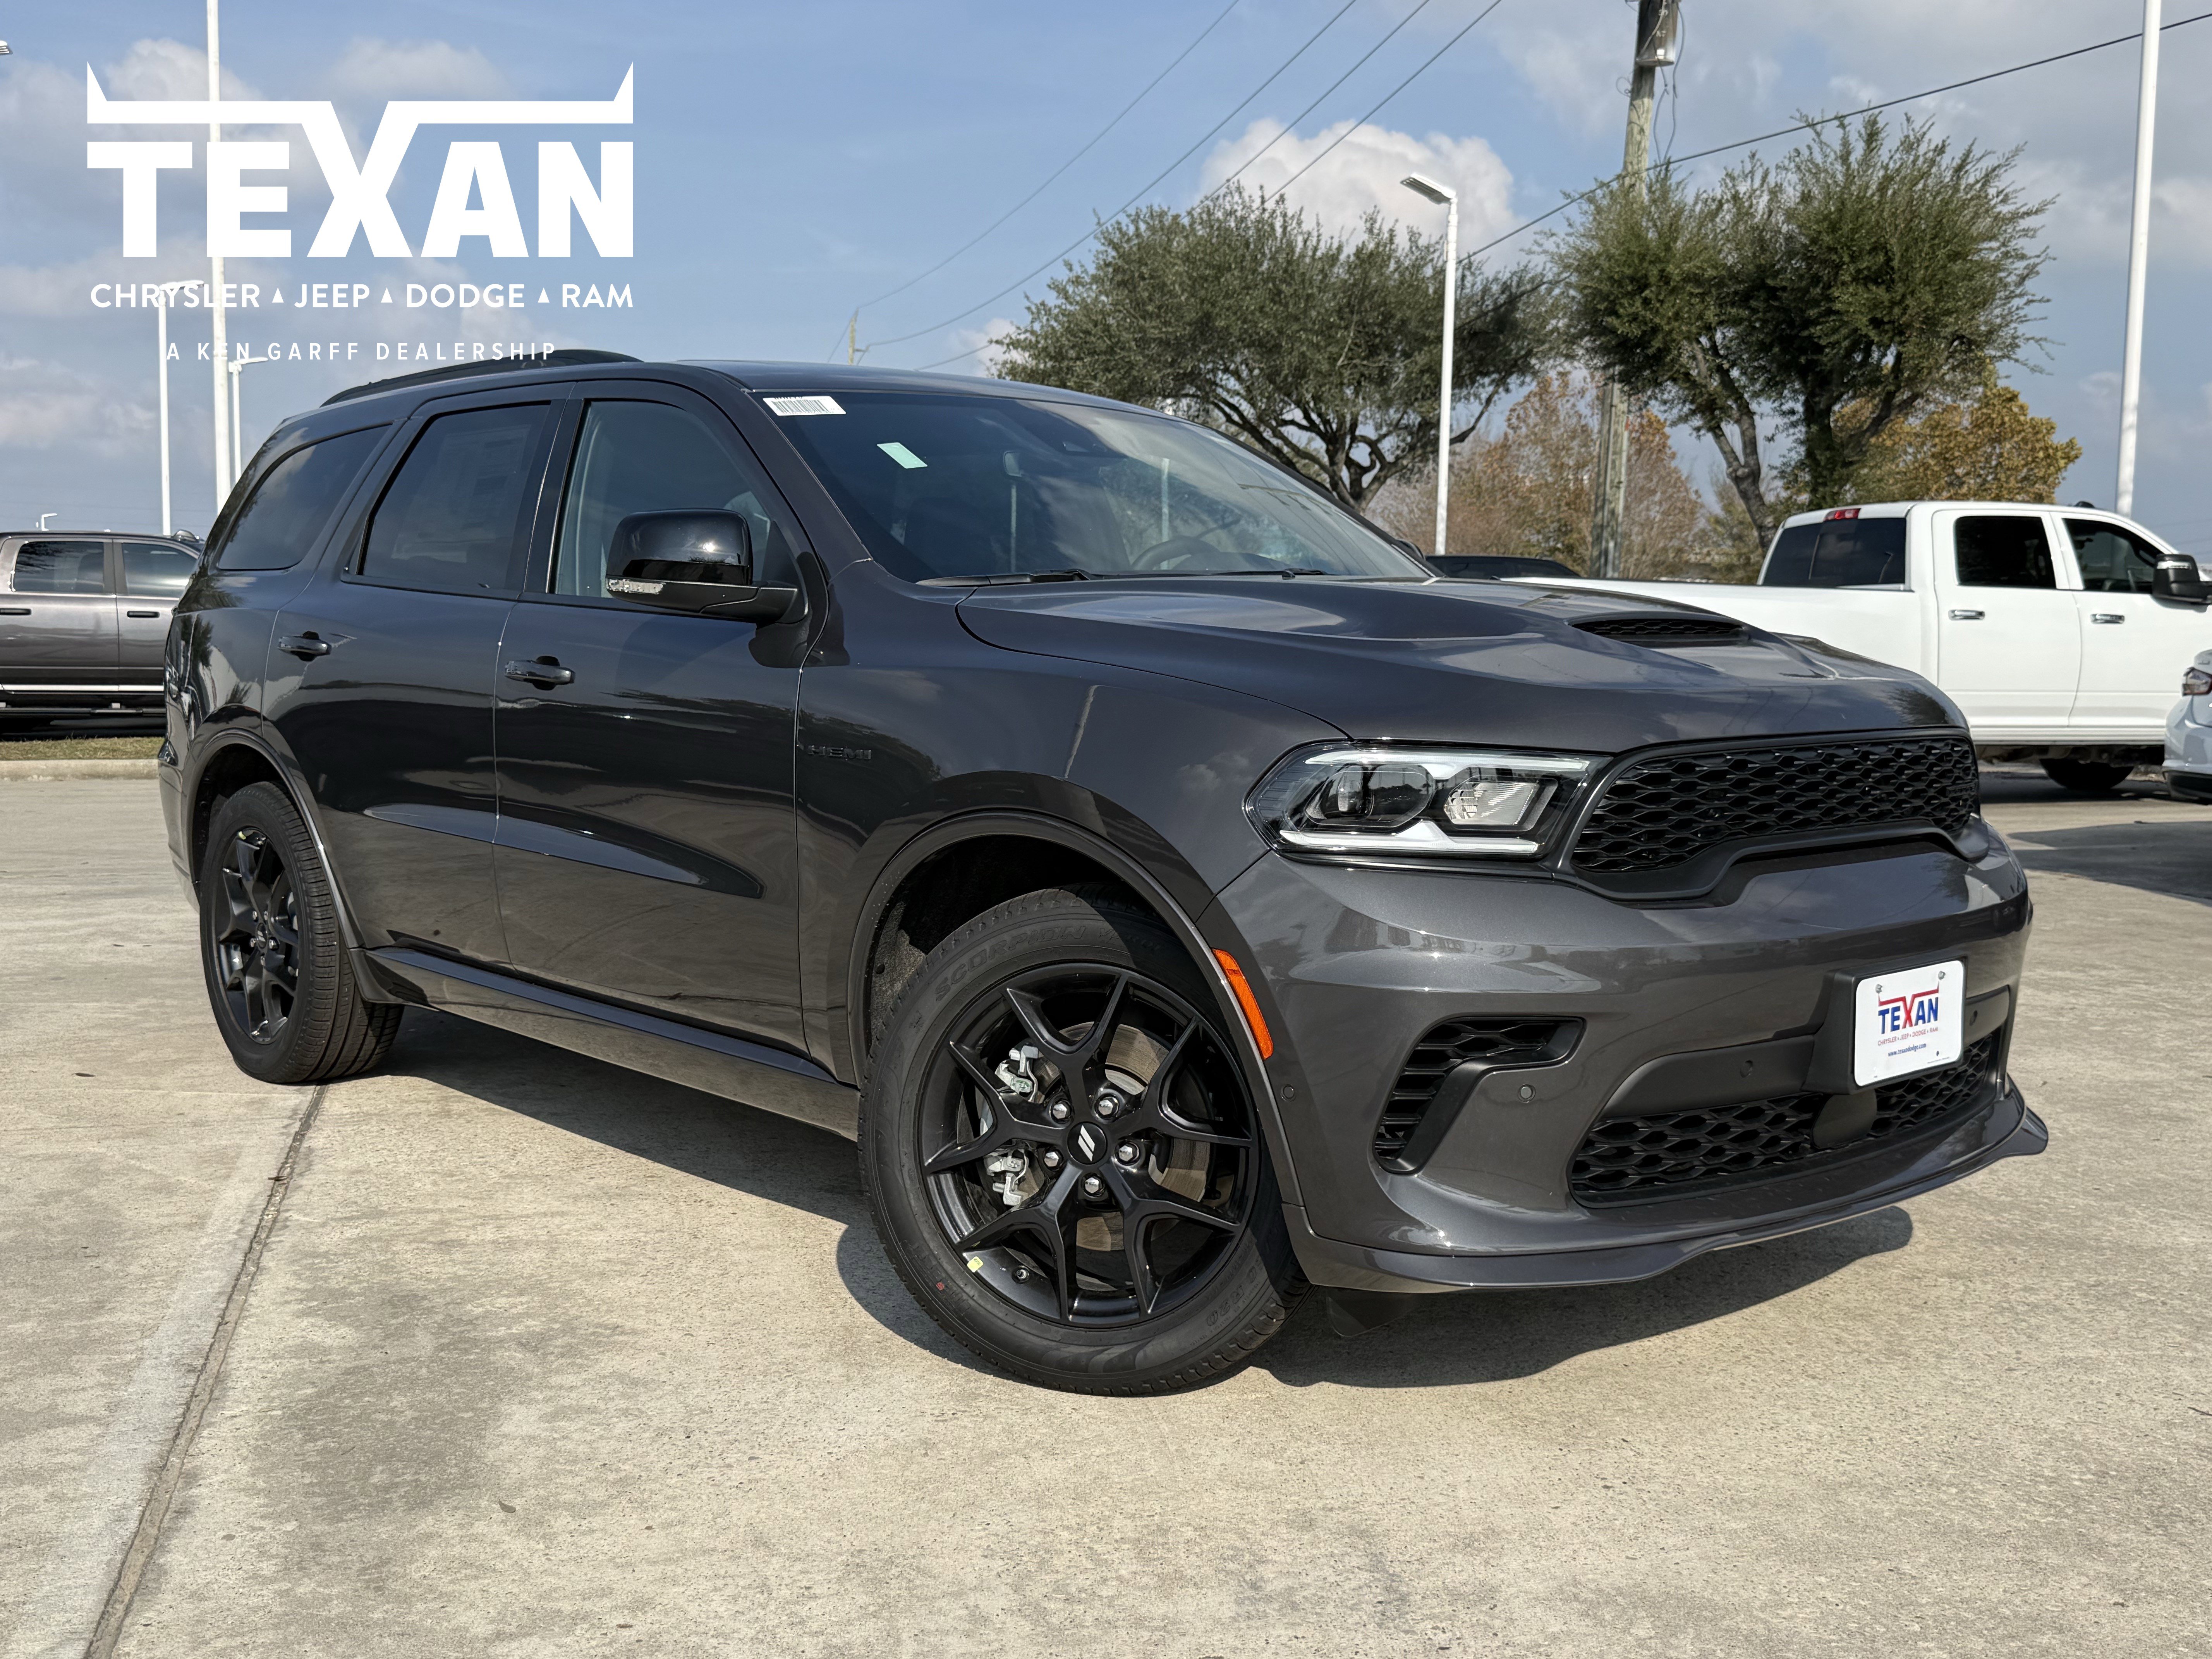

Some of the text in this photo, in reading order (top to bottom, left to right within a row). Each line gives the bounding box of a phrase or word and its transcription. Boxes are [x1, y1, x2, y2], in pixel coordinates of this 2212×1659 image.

[1878, 989, 1939, 1034] TEXAN
[1877, 1036, 1897, 1046] CHRYSLER
[1912, 1029, 1926, 1037] DODGE
